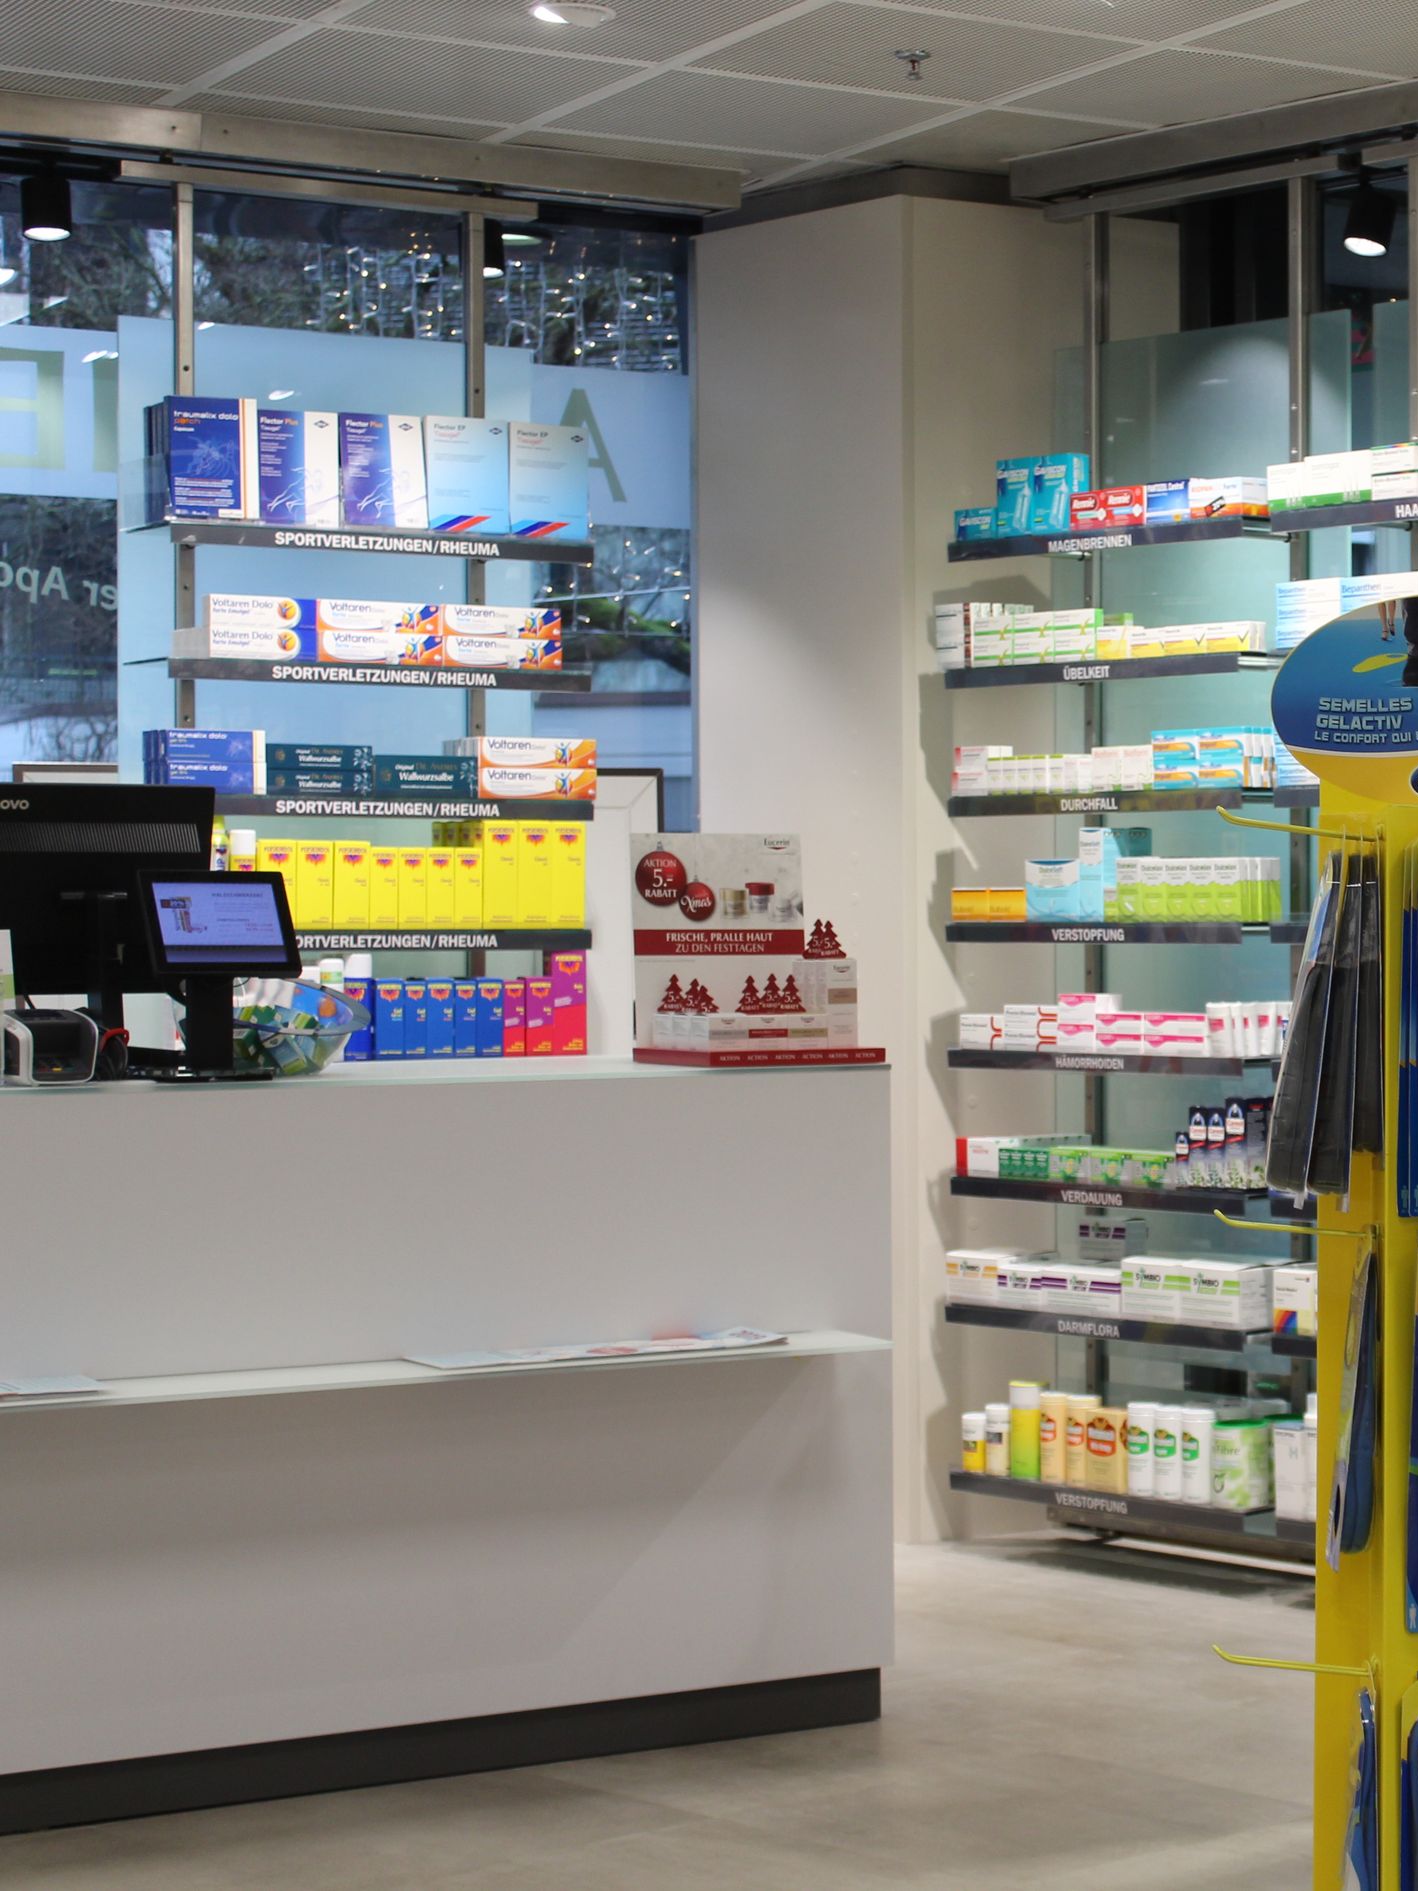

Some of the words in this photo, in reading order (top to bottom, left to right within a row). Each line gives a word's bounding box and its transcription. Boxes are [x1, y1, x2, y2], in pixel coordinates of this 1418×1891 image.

[274, 531, 499, 556] SPORTVERLETZUNGEN/RHEUMA
[1047, 534, 1133, 553] MAGENBRENNEN
[1341, 584, 1382, 594] Bepanthen
[212, 598, 250, 609] Voltaren
[329, 601, 372, 614] Voltaren
[454, 606, 496, 618] Voltaren
[212, 630, 250, 641] Voltaren
[333, 632, 376, 645] Voltaren
[455, 637, 497, 649] Voltaren
[272, 664, 497, 688] SPORTVERLETZUNGEN/RHEUMA
[1063, 664, 1110, 681] ÜBELKEIT
[1318, 696, 1414, 712] SEMELLES
[1315, 713, 1404, 730] GELACTIV
[1314, 731, 1331, 742] LE
[1391, 730, 1413, 743] QUI
[487, 739, 532, 751] Voltaren
[487, 769, 532, 782] Voltaren
[275, 799, 500, 817] SPORTVERLETZUNGEN/RHEUMA
[1060, 798, 1118, 812] DURCHFALL
[644, 889, 678, 899] RABATT
[666, 932, 708, 944] FRISCHE,
[710, 932, 744, 943] PRALLE
[746, 932, 773, 942] HAUT
[1051, 928, 1125, 942] VERSTOPFUNG
[675, 943, 689, 953] ZU
[691, 943, 712, 953] DEN
[713, 943, 765, 953] FESTTAGEN
[1055, 1055, 1125, 1071] HÄMORRHOIDEN
[1060, 1189, 1123, 1207] VERDAUUNG
[1057, 1319, 1121, 1339] DARMFLORA
[1055, 1492, 1129, 1515] VERSTOPFUNG
